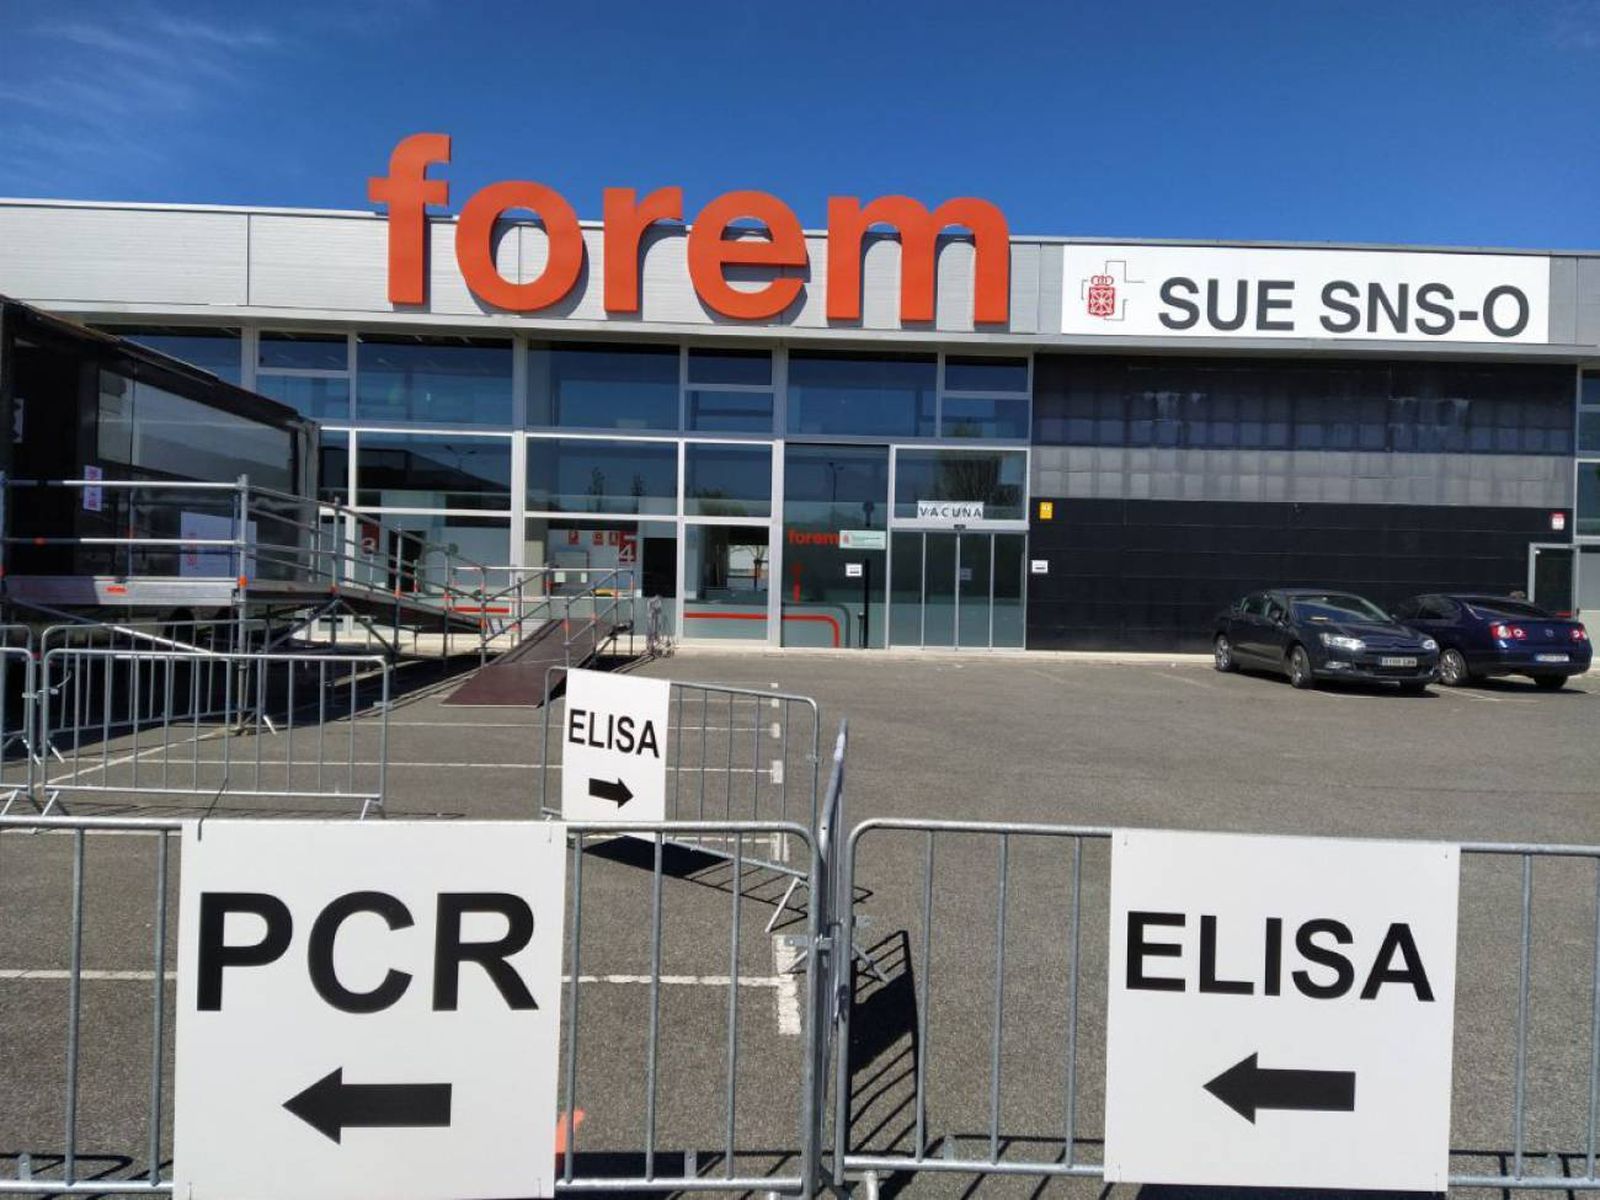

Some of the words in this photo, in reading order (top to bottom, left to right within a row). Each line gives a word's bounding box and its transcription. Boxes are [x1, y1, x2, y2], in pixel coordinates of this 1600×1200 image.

[367, 132, 1010, 326] forem
[1158, 276, 1295, 332] SUE
[1319, 280, 1530, 338] SNS-O
[788, 529, 841, 544] forem
[919, 506, 983, 519] VACUNA
[619, 543, 635, 565] 4
[568, 707, 660, 760] ELISA
[197, 890, 539, 1014] PCR
[1126, 910, 1436, 1002] ELISA
